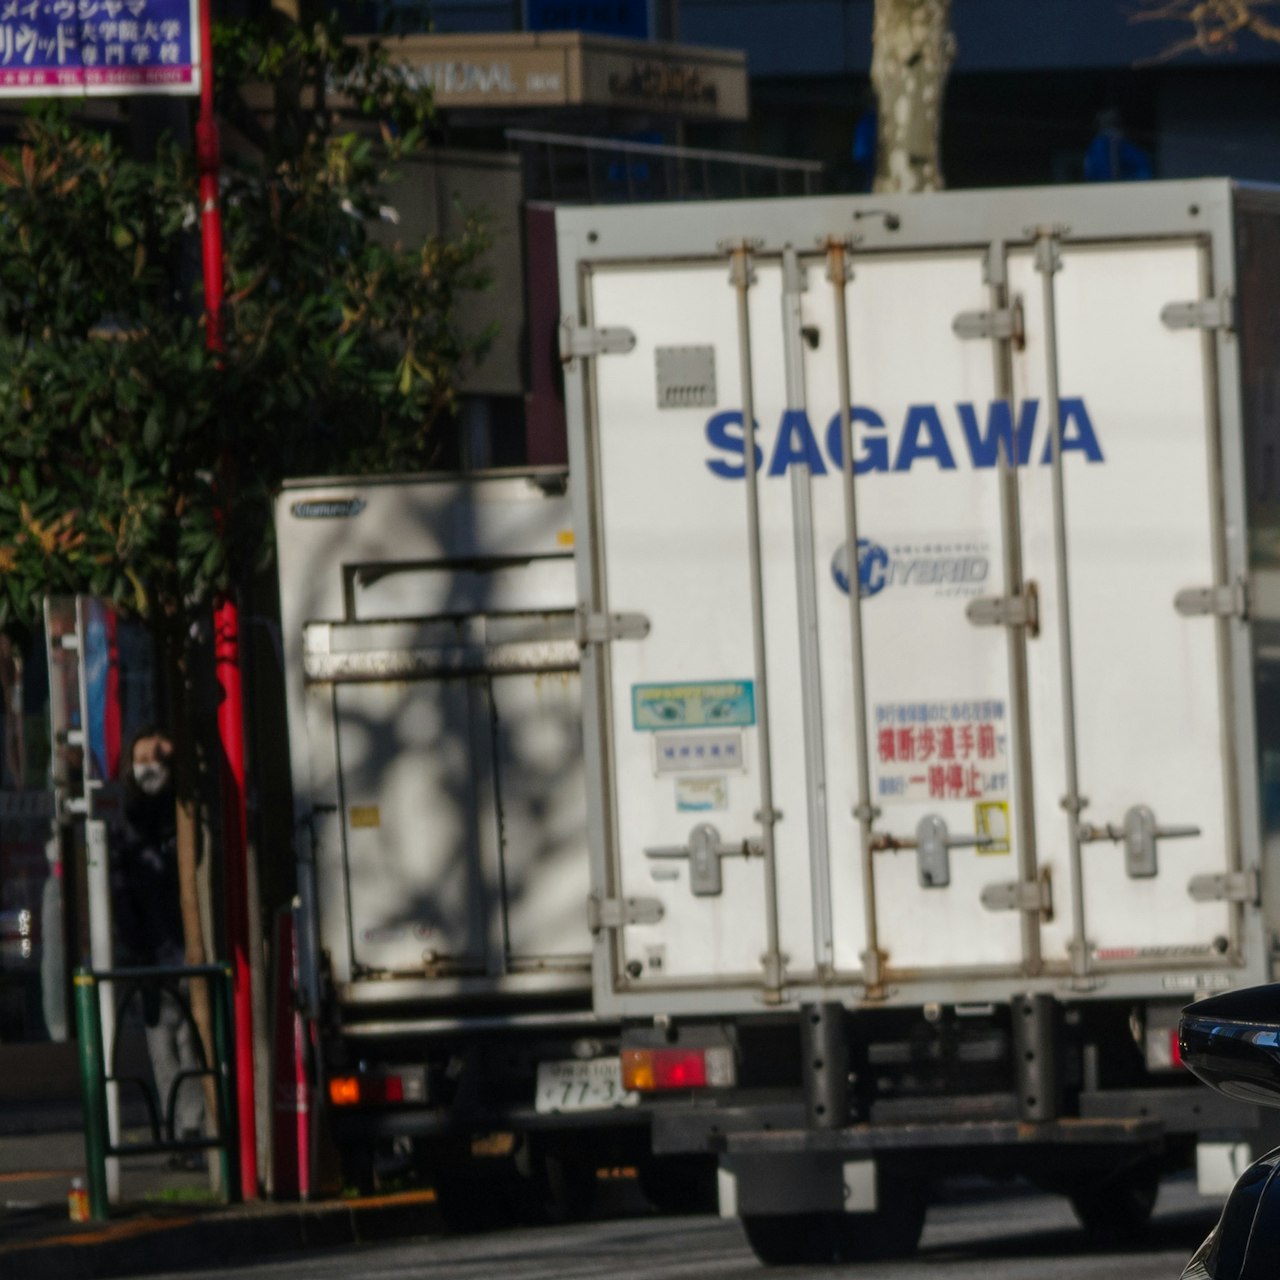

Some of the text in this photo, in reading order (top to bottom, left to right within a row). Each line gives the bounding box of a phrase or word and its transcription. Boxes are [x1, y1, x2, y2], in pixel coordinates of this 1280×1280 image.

[82, 20, 182, 43] 大学院大学
[82, 43, 181, 66] 専門学校
[703, 396, 1105, 481] SAGAWA
[867, 557, 989, 590] HYBRID
